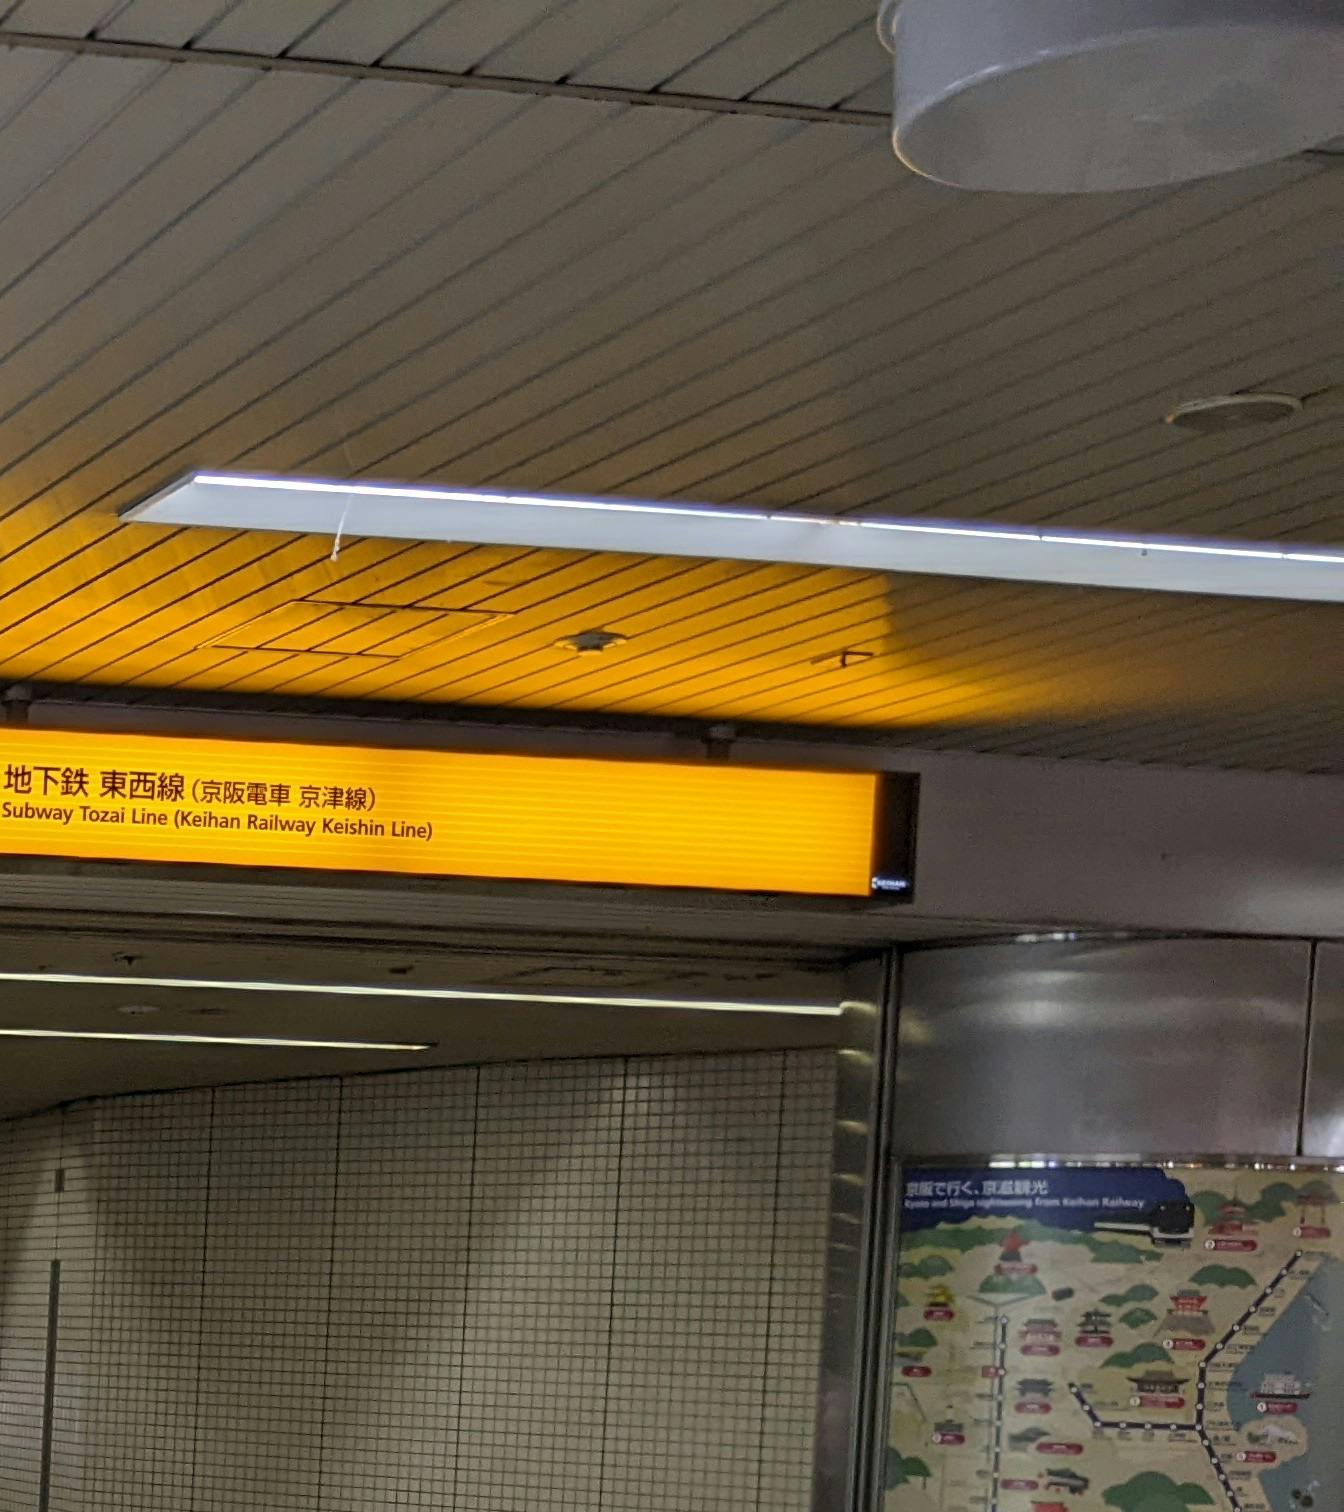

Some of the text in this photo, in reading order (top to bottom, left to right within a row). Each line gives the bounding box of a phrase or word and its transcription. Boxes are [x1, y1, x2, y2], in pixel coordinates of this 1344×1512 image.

[3, 764, 89, 797] 地下鉄
[100, 769, 184, 802] 東西線
[299, 785, 376, 812] 京津線)
[2, 801, 433, 842] Subway Tozai Line (Keihan Railway Keishin Line)
